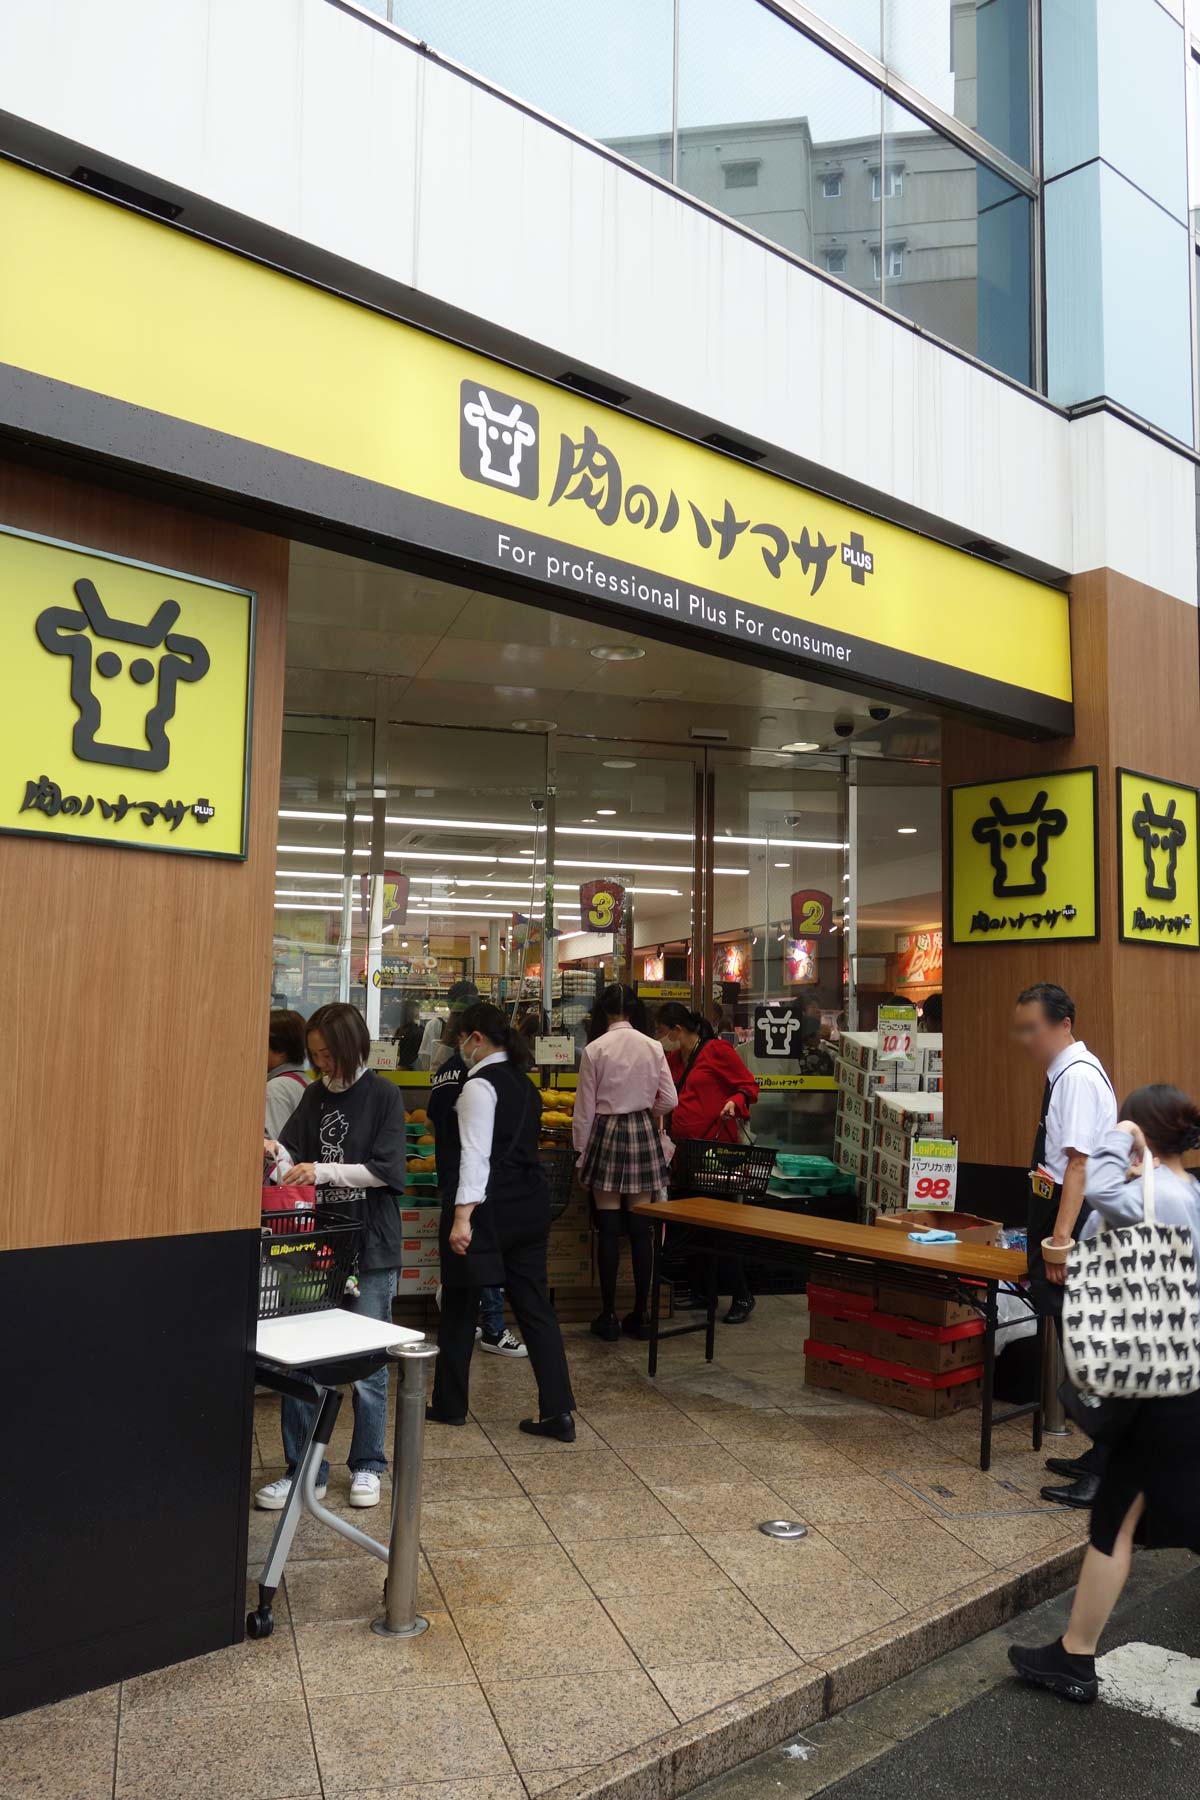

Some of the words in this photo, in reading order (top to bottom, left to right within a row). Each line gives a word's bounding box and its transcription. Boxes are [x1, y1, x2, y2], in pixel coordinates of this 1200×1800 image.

[548, 425, 837, 597] 肉のハナマサ
[843, 546, 872, 571] PLUS
[497, 534, 536, 566] For
[547, 556, 680, 612] professional
[689, 594, 727, 626] Plus
[735, 610, 764, 637] For
[771, 626, 852, 663] consumer
[19, 775, 192, 832] 肉のハナマサ
[194, 805, 214, 816] PLUS
[588, 892, 615, 927] 3
[800, 900, 826, 935] 2
[915, 1178, 950, 1199] 98
